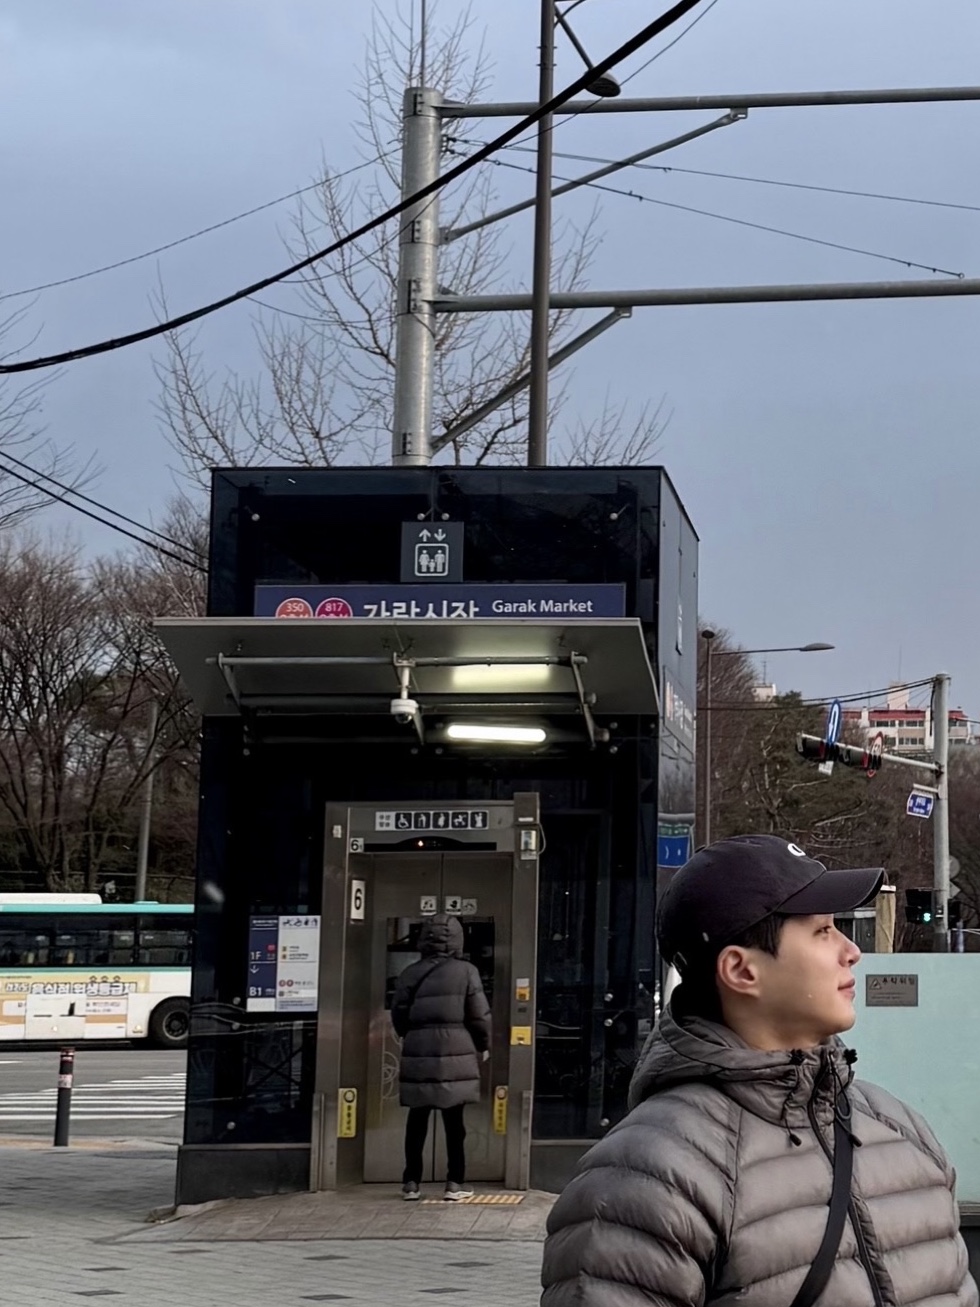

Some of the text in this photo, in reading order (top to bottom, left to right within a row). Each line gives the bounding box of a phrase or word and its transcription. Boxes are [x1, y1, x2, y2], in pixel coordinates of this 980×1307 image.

[286, 602, 304, 612] 350
[324, 602, 344, 612] 817
[492, 600, 593, 613] Garak Market
[354, 888, 363, 910] 6
[249, 986, 262, 997] B1
